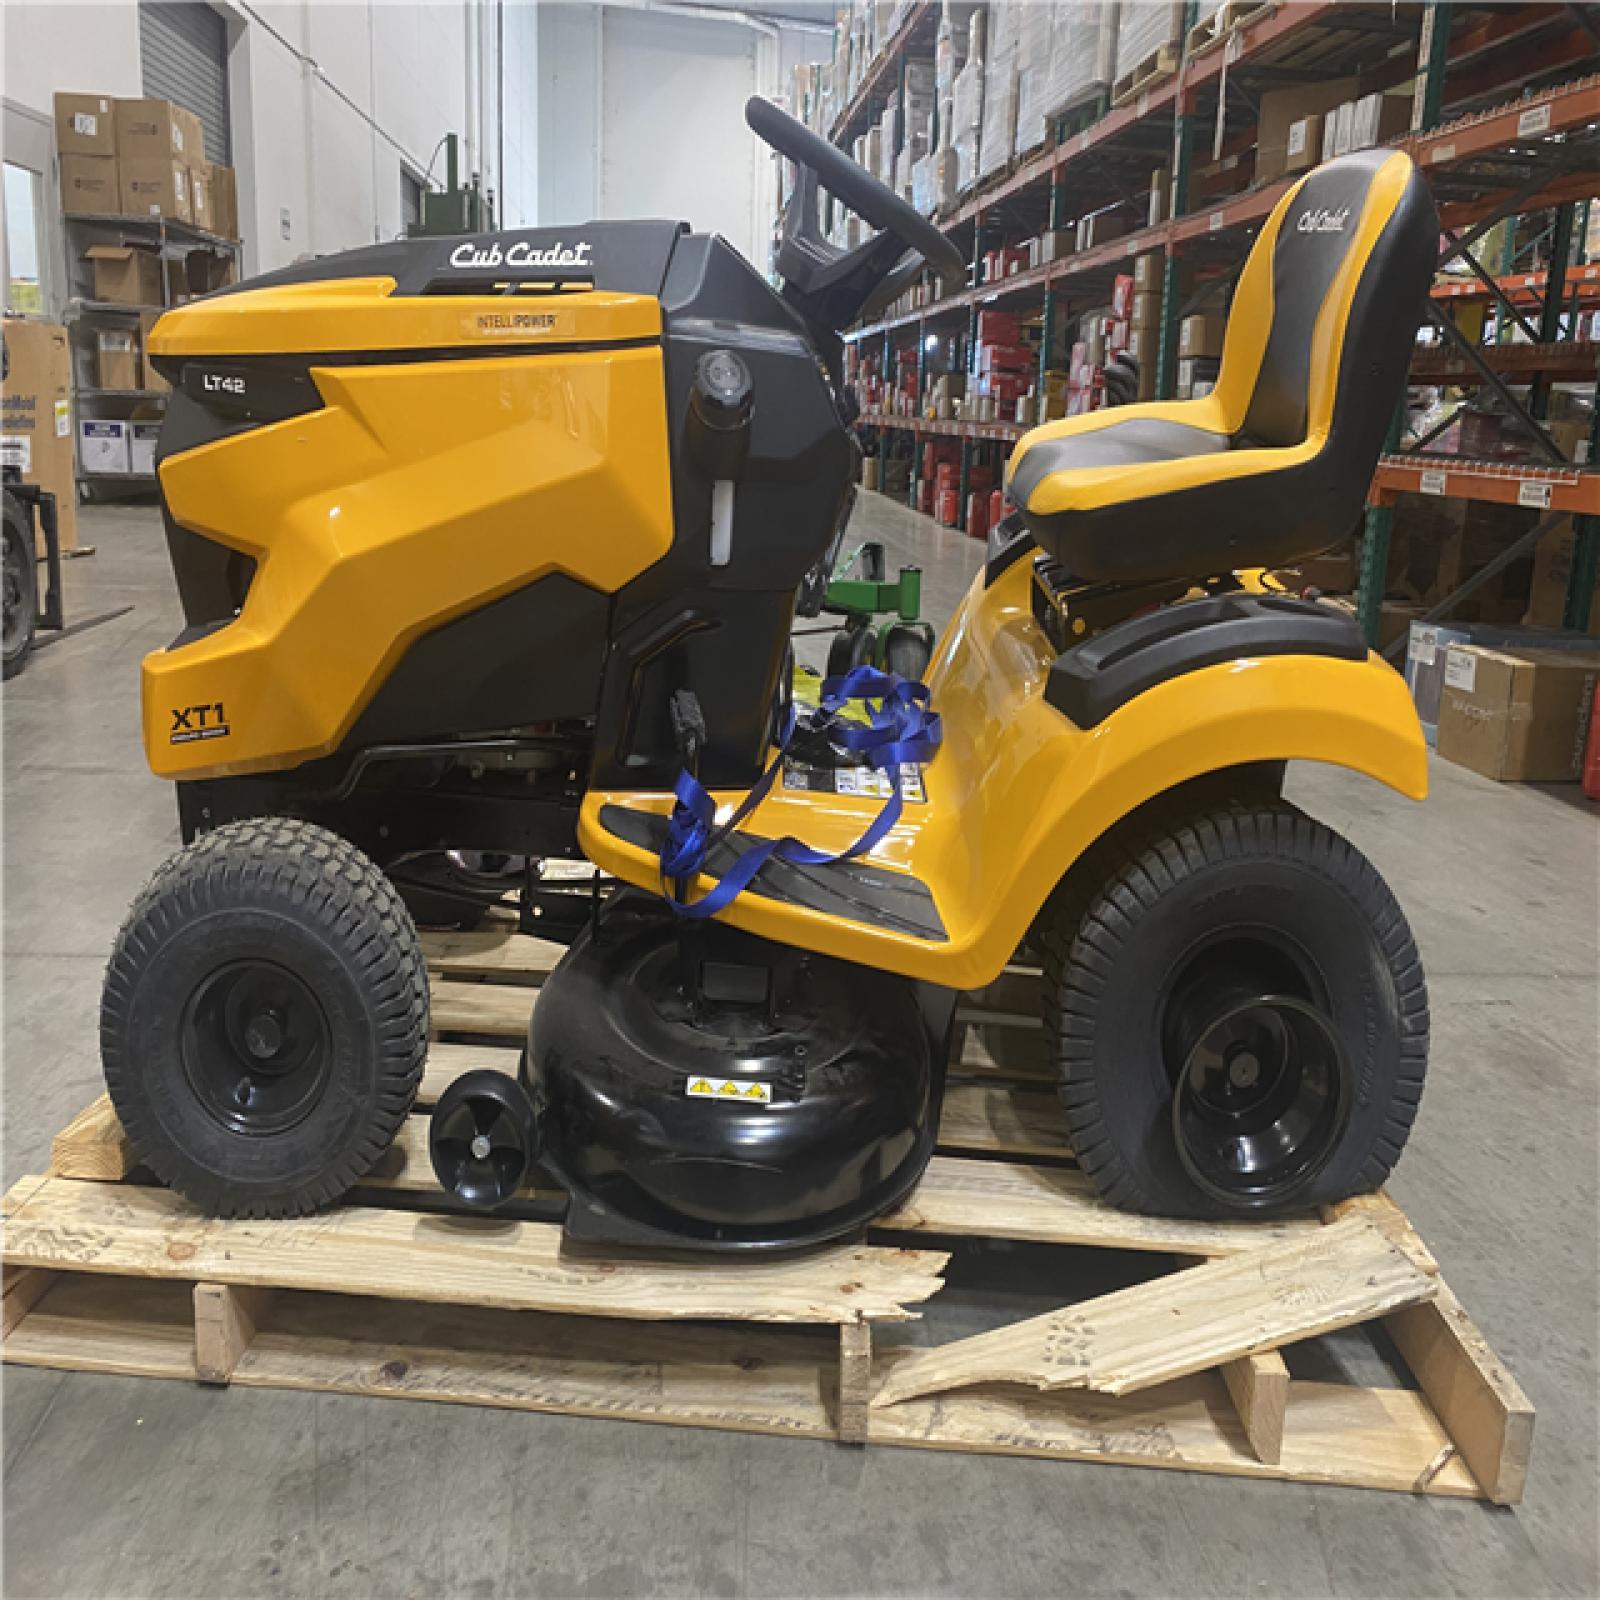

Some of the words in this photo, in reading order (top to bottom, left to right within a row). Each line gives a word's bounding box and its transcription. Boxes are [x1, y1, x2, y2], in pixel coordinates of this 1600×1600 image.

[450, 242, 501, 268] Cub
[505, 242, 592, 267] Cadet
[477, 314, 557, 329] INTELLIPOWER
[204, 374, 246, 393] LT42
[171, 702, 224, 730] XT1
